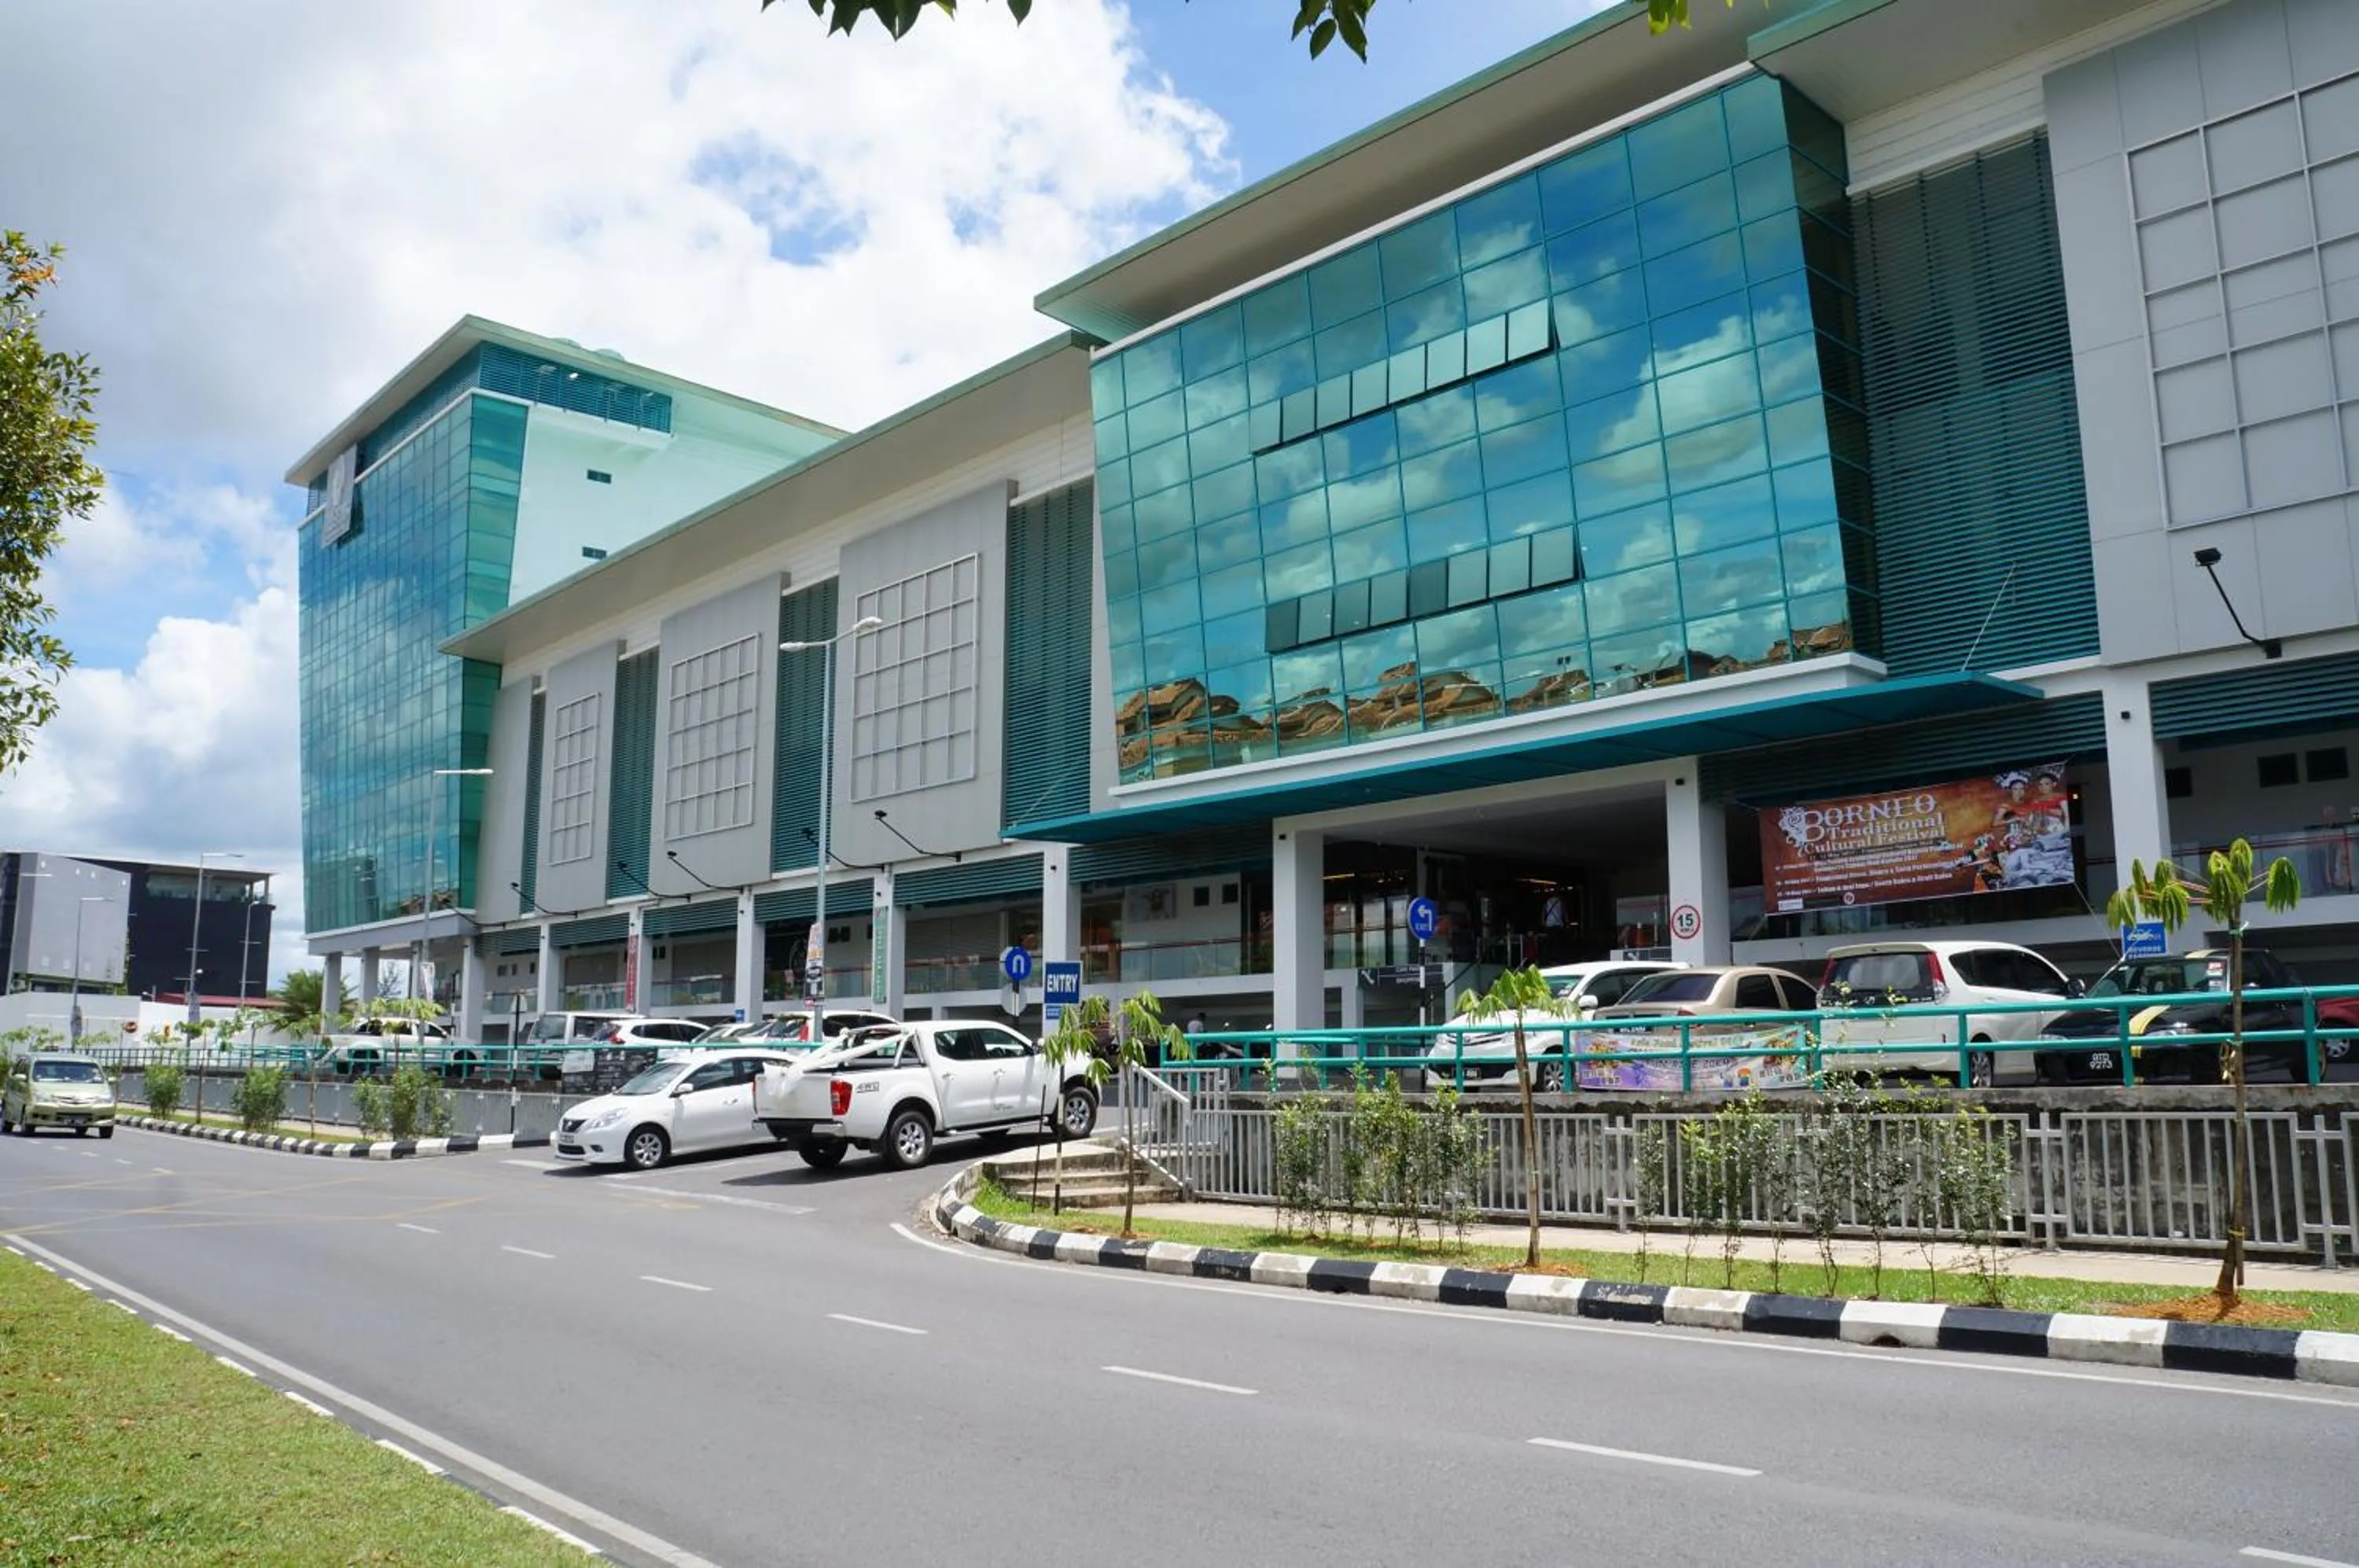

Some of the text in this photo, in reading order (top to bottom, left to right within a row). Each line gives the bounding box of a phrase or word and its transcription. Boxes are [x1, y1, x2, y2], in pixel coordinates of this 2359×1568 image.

[1826, 812, 1944, 840] Traditional
[1804, 834, 1872, 855] Cultural
[1879, 824, 1945, 846] Festival
[1677, 913, 1694, 927] 15
[1047, 974, 1078, 993] ENTRY
